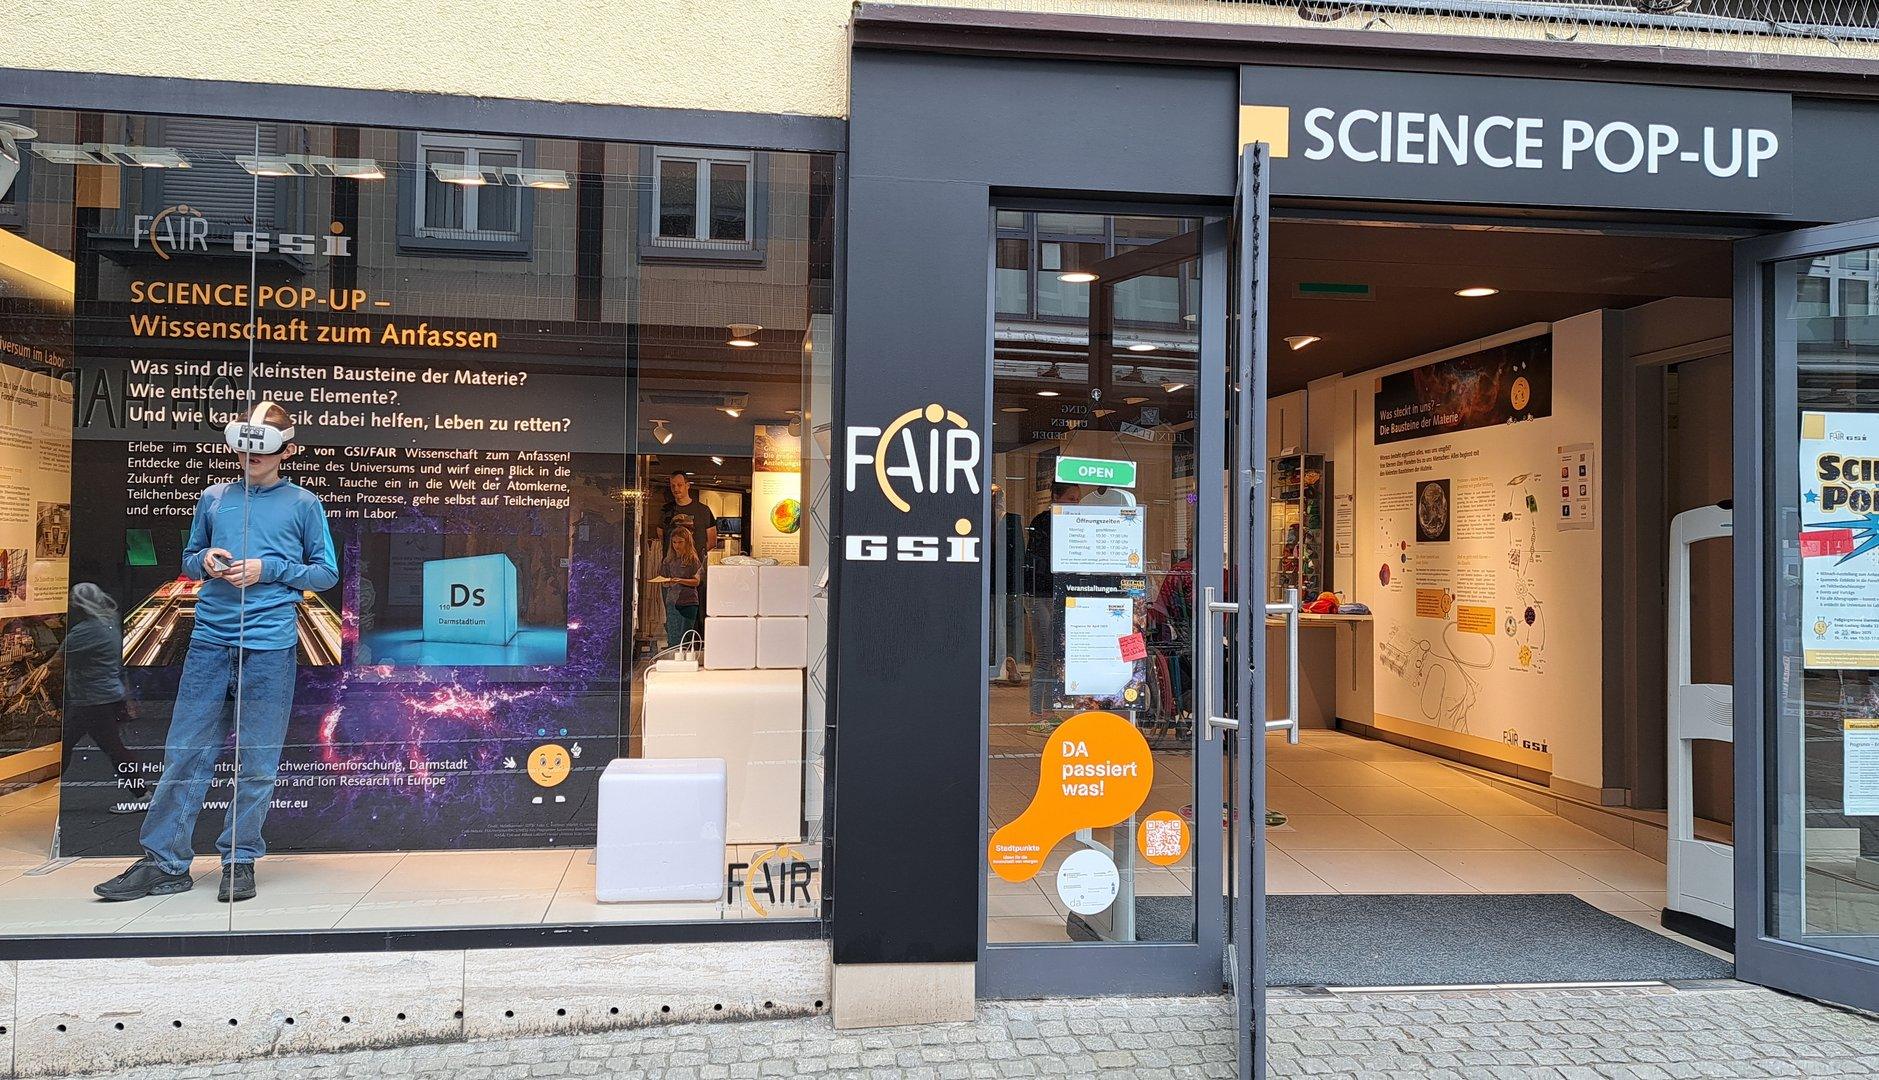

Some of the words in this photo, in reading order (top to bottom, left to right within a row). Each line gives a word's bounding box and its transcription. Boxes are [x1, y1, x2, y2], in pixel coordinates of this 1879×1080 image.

[1303, 106, 1544, 169] SCIENCE
[1563, 120, 1780, 178] POP-UP
[134, 208, 208, 256] FAIR
[130, 281, 248, 306] SCIENCE
[258, 285, 367, 311] POP-UP
[129, 314, 308, 341] Wissenschaft
[317, 325, 370, 343] zum
[380, 323, 497, 348] Anfassen
[45, 349, 65, 368] Labor
[130, 359, 169, 376] Was
[174, 361, 211, 376] sind
[216, 362, 244, 377] die
[251, 364, 326, 380] kleinsten
[333, 366, 416, 383] Bausteine
[421, 368, 449, 383] der
[454, 370, 527, 386] Materie?
[129, 383, 165, 398] Wie
[170, 385, 256, 401] entstehen
[262, 389, 305, 403] neue
[310, 388, 398, 405] Elemente?
[129, 407, 165, 422] Und
[171, 408, 203, 423] wie
[209, 408, 239, 424] kan
[318, 411, 365, 427] dabei
[371, 412, 429, 431] helfen,
[435, 415, 484, 430] Leben
[489, 419, 508, 431] zu
[514, 418, 571, 433] retten?
[1380, 410, 1392, 421] Was
[1394, 405, 1411, 418] steckt
[1412, 404, 1418, 414] in
[1420, 400, 1434, 412] uns?
[1380, 426, 1390, 436] Die
[1390, 420, 1419, 433] Bausteine
[1421, 417, 1431, 427] der
[1432, 412, 1458, 426] Materie
[128, 442, 169, 453] Erlebe
[172, 442, 187, 453] im
[195, 443, 237, 454] SCIEN
[313, 447, 335, 456] von
[344, 446, 396, 458] GSI/FAIR
[405, 448, 478, 460] Wissenschaft
[486, 452, 509, 461] zum
[517, 450, 570, 462] Anfassen!
[846, 414, 981, 503] FAIR
[128, 458, 180, 469] Entdecke
[185, 458, 203, 469] die
[208, 459, 240, 470] kleins
[325, 461, 345, 472] des
[350, 462, 415, 473] Universums
[420, 463, 442, 474] und
[447, 463, 469, 475] wirf
[474, 464, 504, 475] einen
[510, 465, 534, 476] Blick
[539, 466, 549, 476] in
[554, 466, 571, 477] die
[1078, 466, 1114, 479] OPEN
[127, 473, 174, 484] Zukunft
[180, 474, 200, 484] der
[206, 474, 243, 485] Forsch
[299, 476, 330, 487] FAIR.
[338, 477, 378, 488] Tauche
[384, 478, 402, 488] ein
[408, 478, 419, 489] in
[425, 478, 442, 489] die
[449, 479, 476, 490] Welt
[482, 480, 501, 491] der
[506, 480, 570, 493] Atomkerne,
[356, 493, 407, 505] Prozesse,
[412, 494, 440, 507] gehe
[444, 494, 476, 505] selbst
[480, 494, 499, 506] auf
[503, 495, 570, 509] Teilchenjagd
[126, 504, 149, 515] und
[345, 508, 359, 518] im
[364, 508, 398, 519] Labor.
[451, 584, 486, 607] Ds
[1066, 584, 1118, 593] Veranstaltungen
[1062, 741, 1089, 758] DA
[118, 762, 138, 773] GSI
[409, 759, 468, 770] Darmstadt
[1062, 760, 1138, 780] passiert
[117, 778, 145, 789] FAIR
[292, 776, 314, 787] and
[318, 776, 336, 786] Ion
[340, 776, 389, 786] Research
[394, 775, 403, 785] in
[407, 775, 446, 788] Europe
[1062, 780, 1105, 797] was!
[996, 844, 1040, 852] Stadtpunkte
[728, 852, 813, 911] FAIR
